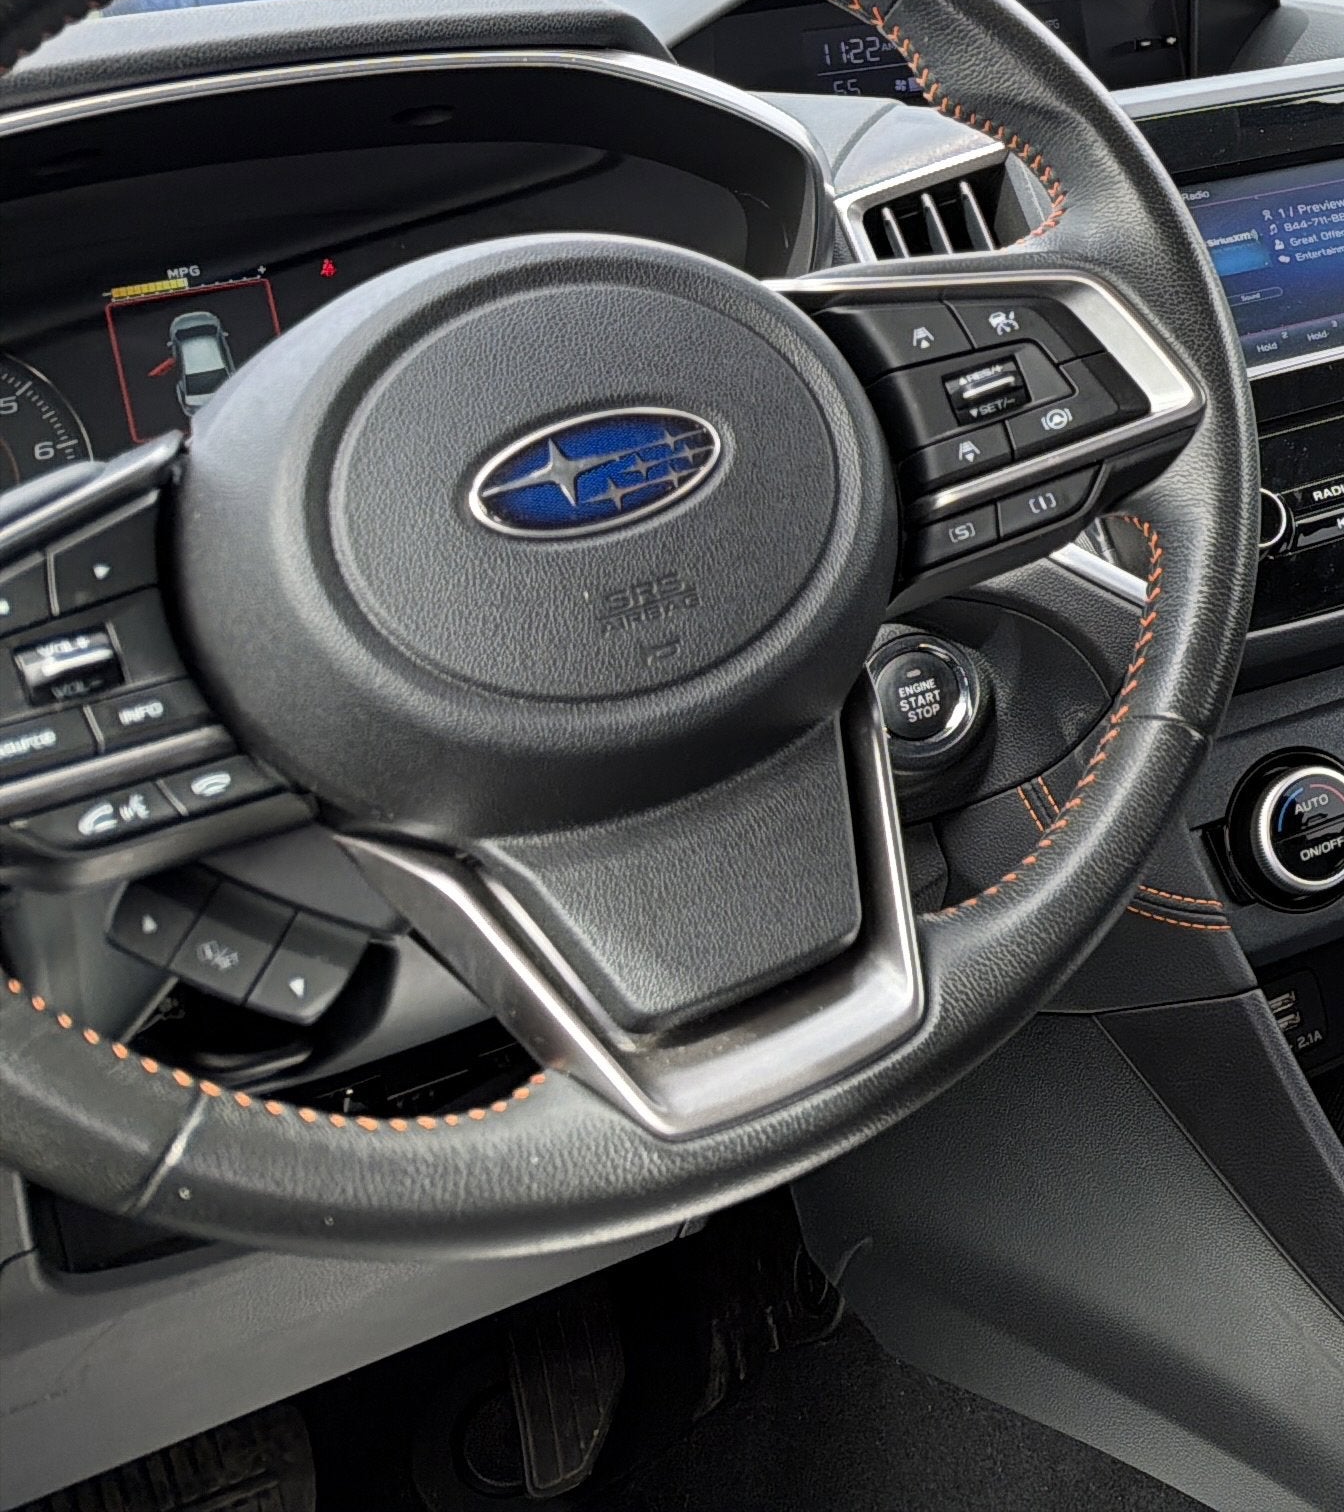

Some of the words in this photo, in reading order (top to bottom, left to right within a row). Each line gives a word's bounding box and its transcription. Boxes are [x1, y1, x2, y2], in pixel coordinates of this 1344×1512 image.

[823, 36, 880, 66] 11:22
[1181, 190, 1210, 201] Radio
[1290, 235, 1318, 248] Great
[1320, 229, 1344, 242] Offer
[166, 265, 201, 279] MPG
[1307, 330, 1327, 342] Hold
[1257, 342, 1278, 354] Hold
[0, 396, 19, 415] 5
[34, 441, 55, 461] 6
[898, 678, 937, 699] ENGINE
[899, 689, 941, 712] START
[118, 700, 164, 727] INFO
[907, 703, 941, 724] STOP
[1293, 792, 1330, 816] AUTO
[1297, 1030, 1323, 1048] 2.1A
